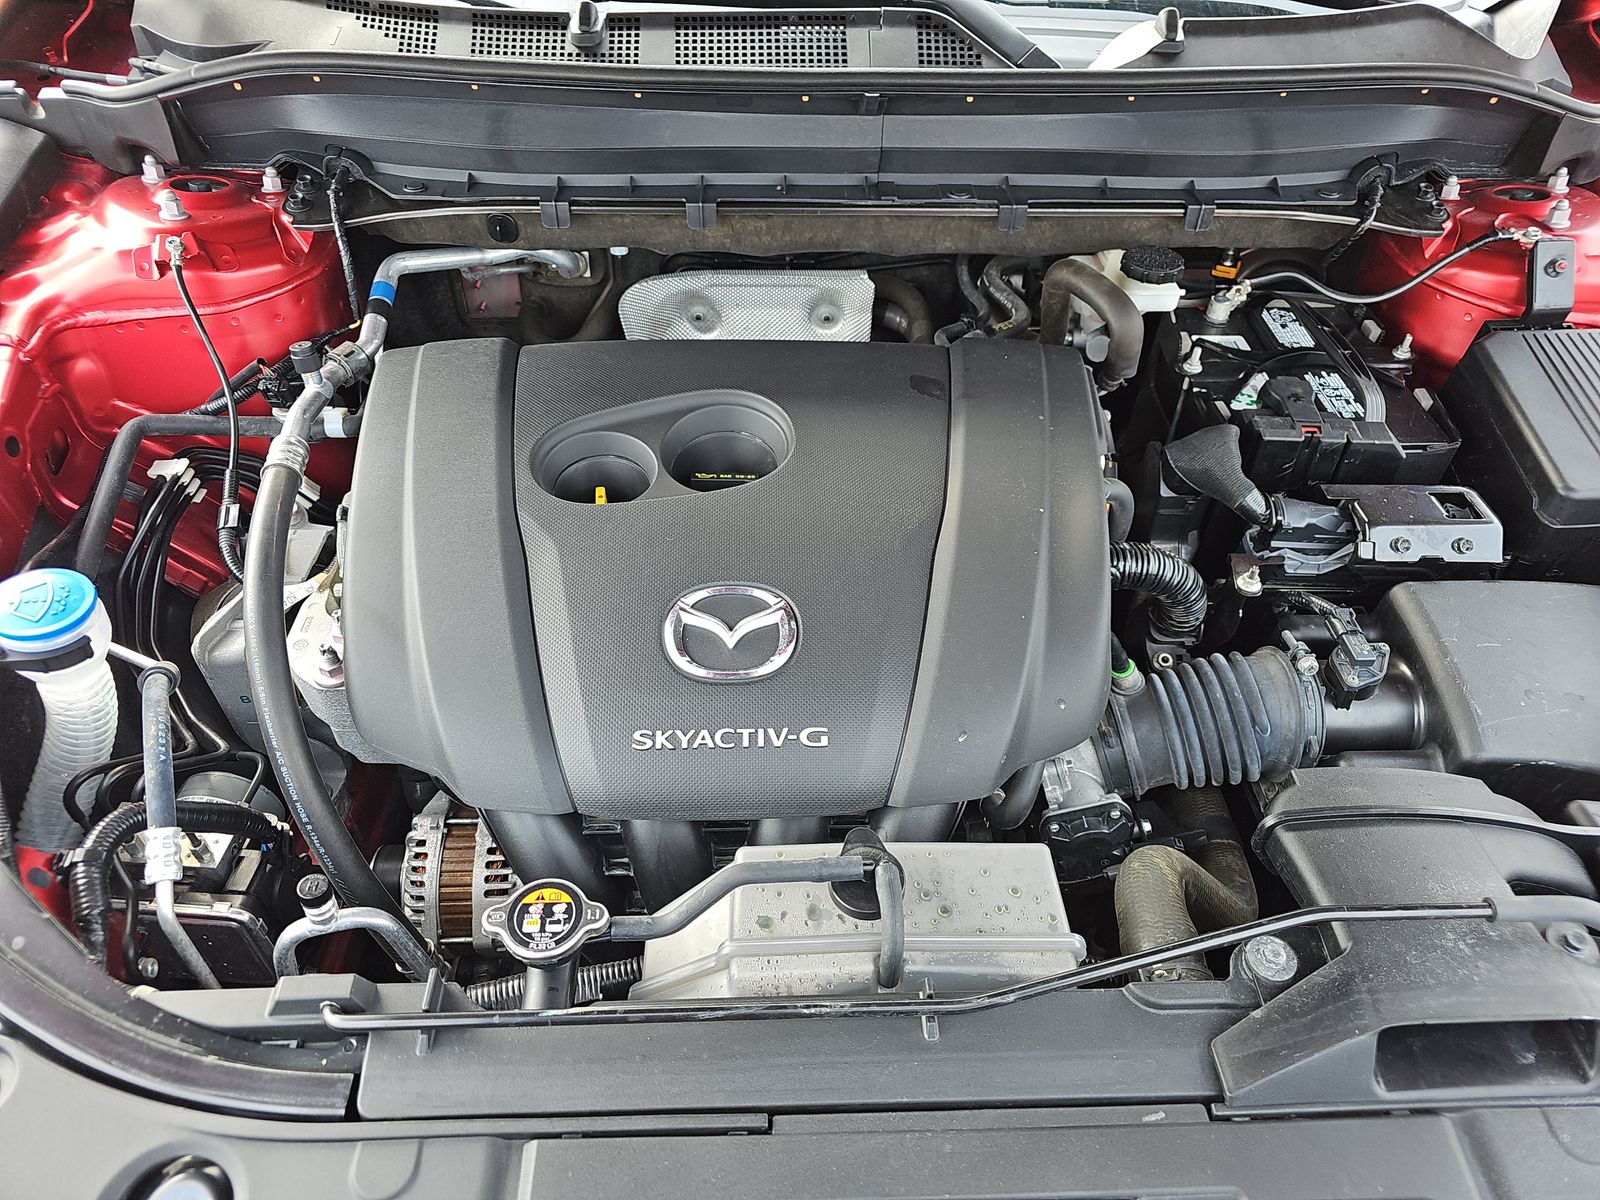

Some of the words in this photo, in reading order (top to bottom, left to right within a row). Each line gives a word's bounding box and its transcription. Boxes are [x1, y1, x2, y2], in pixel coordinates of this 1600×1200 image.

[631, 727, 829, 750] SKYACTIV-G
[262, 707, 279, 749] Flexbarrier
[275, 751, 285, 765] A/C
[280, 766, 300, 801] SUCTION
[295, 802, 309, 823] HOSE
[586, 909, 600, 920] 1.1
